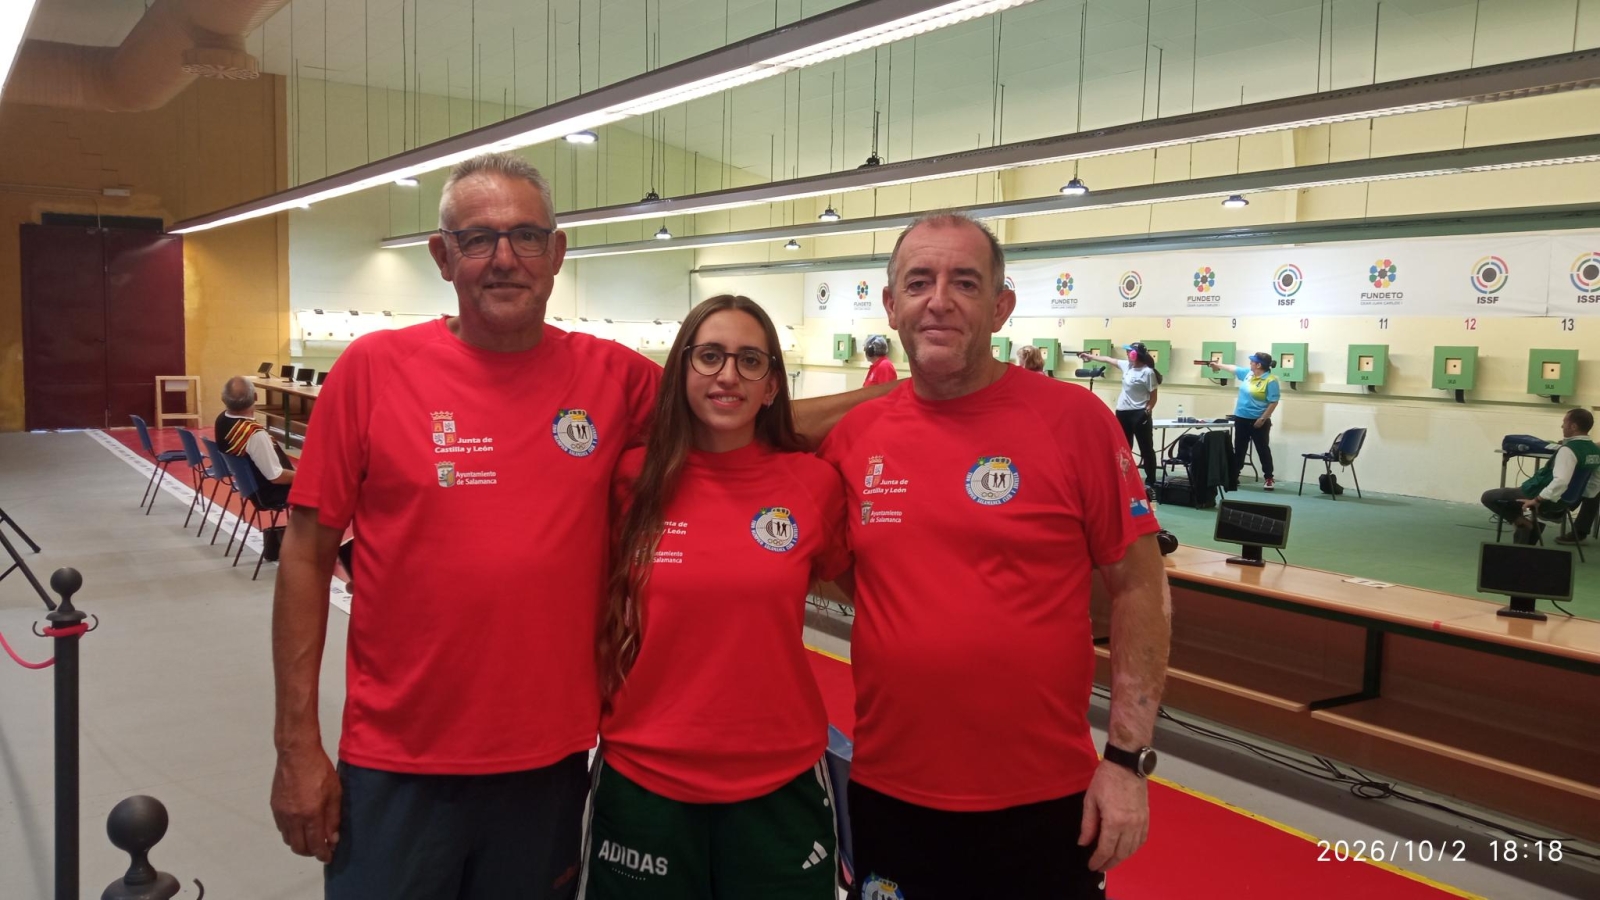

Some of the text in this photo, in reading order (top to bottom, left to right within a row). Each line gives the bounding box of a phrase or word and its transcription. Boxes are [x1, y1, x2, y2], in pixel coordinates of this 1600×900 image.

[1009, 318, 1013, 327] 5
[1105, 318, 1110, 328] 7
[1166, 319, 1171, 328] 8
[1232, 318, 1237, 328] 9
[1300, 318, 1309, 329] 10
[1379, 318, 1388, 329] 11
[1464, 318, 1477, 330] 12
[1561, 318, 1574, 331] 13
[598, 839, 668, 876] ADIDAS
